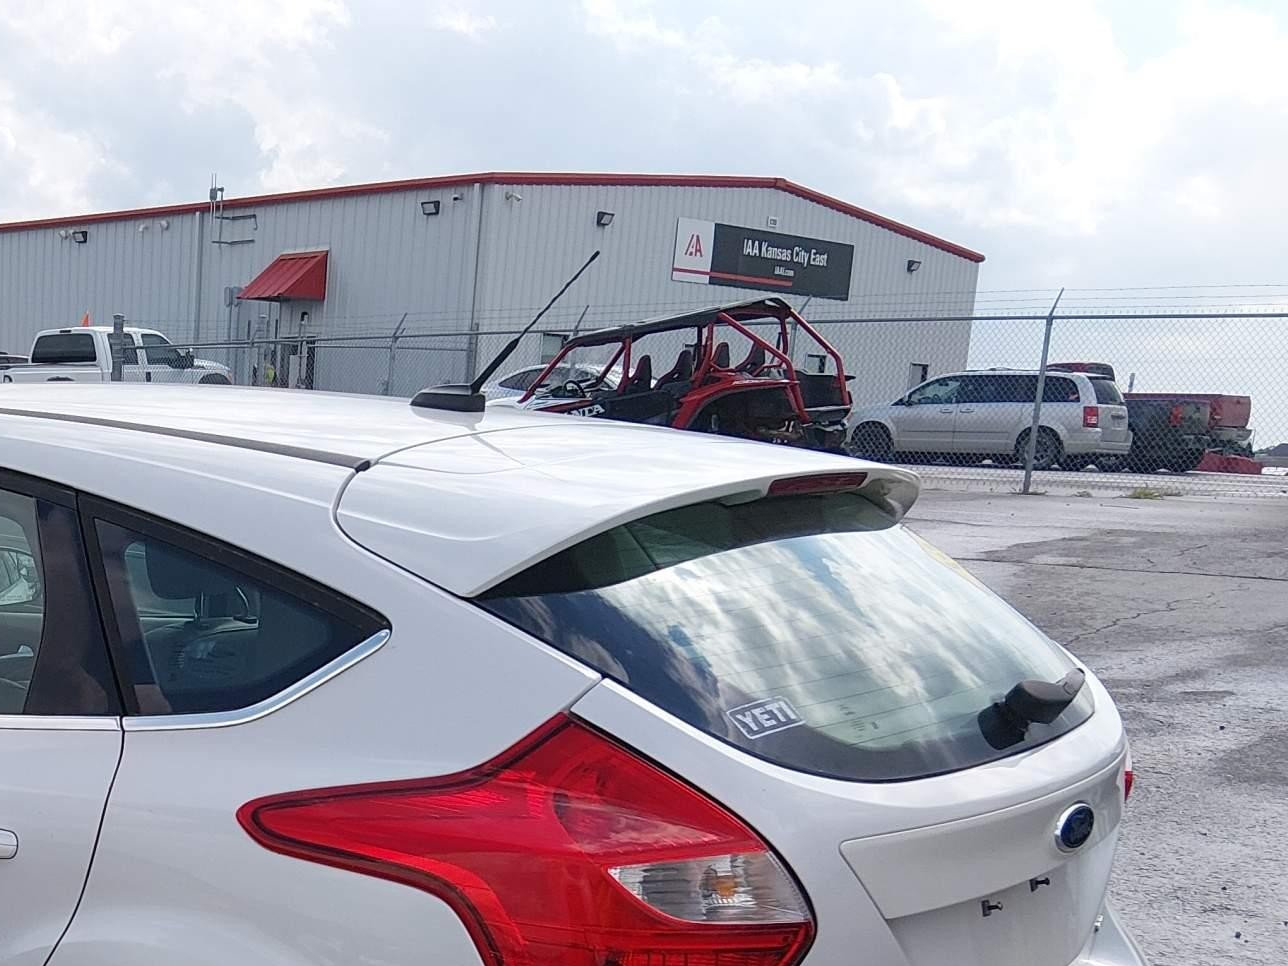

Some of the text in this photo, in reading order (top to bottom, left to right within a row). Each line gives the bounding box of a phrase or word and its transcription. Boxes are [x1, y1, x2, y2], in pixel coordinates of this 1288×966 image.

[743, 239, 828, 267] IAA Kansas City East
[735, 701, 797, 731] YETI
